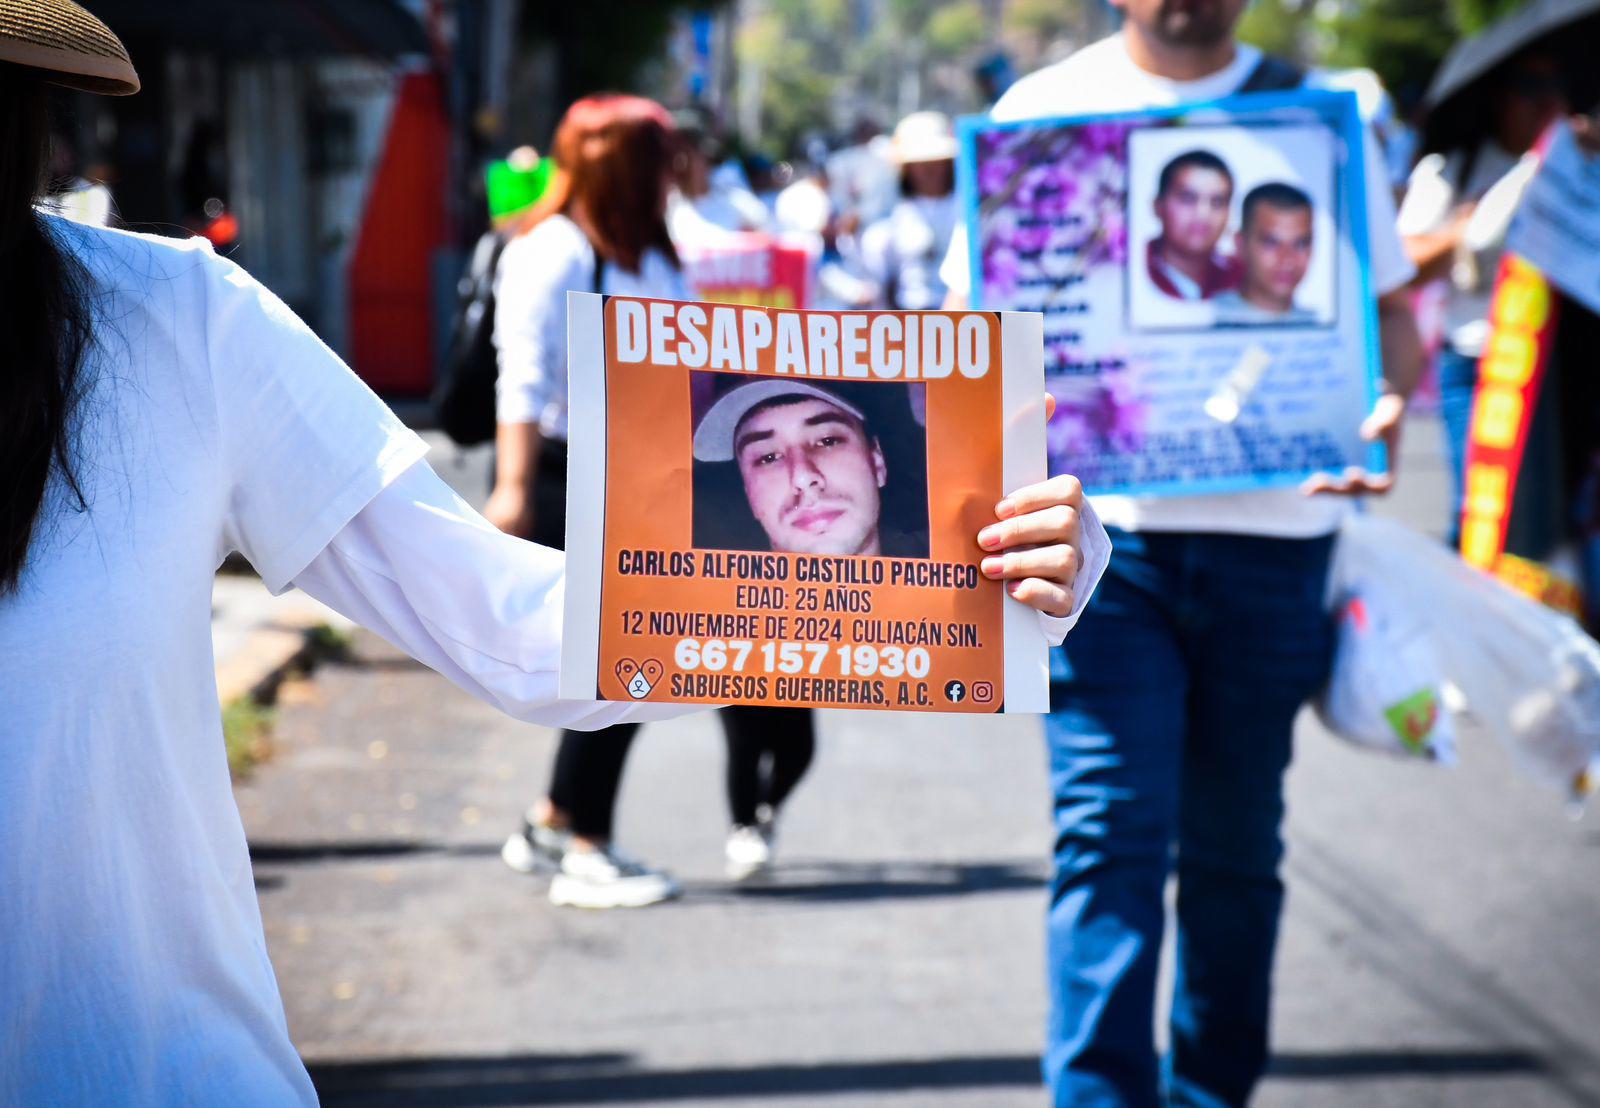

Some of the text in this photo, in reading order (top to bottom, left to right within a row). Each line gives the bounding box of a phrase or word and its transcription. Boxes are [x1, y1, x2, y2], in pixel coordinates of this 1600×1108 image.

[615, 300, 990, 379] DESAPARECIDO
[618, 549, 978, 589] CARLOS ALFONSO CASTILLO PACHECO
[736, 585, 872, 613] EDAD: 25 AÑOS
[621, 610, 984, 648] 12 NOVIEMBRE DE 2024 CULIACÁN SIN.
[674, 639, 930, 679] 667 157 1930
[671, 673, 934, 706] SABUESOS GUERRERAS, A.C.
